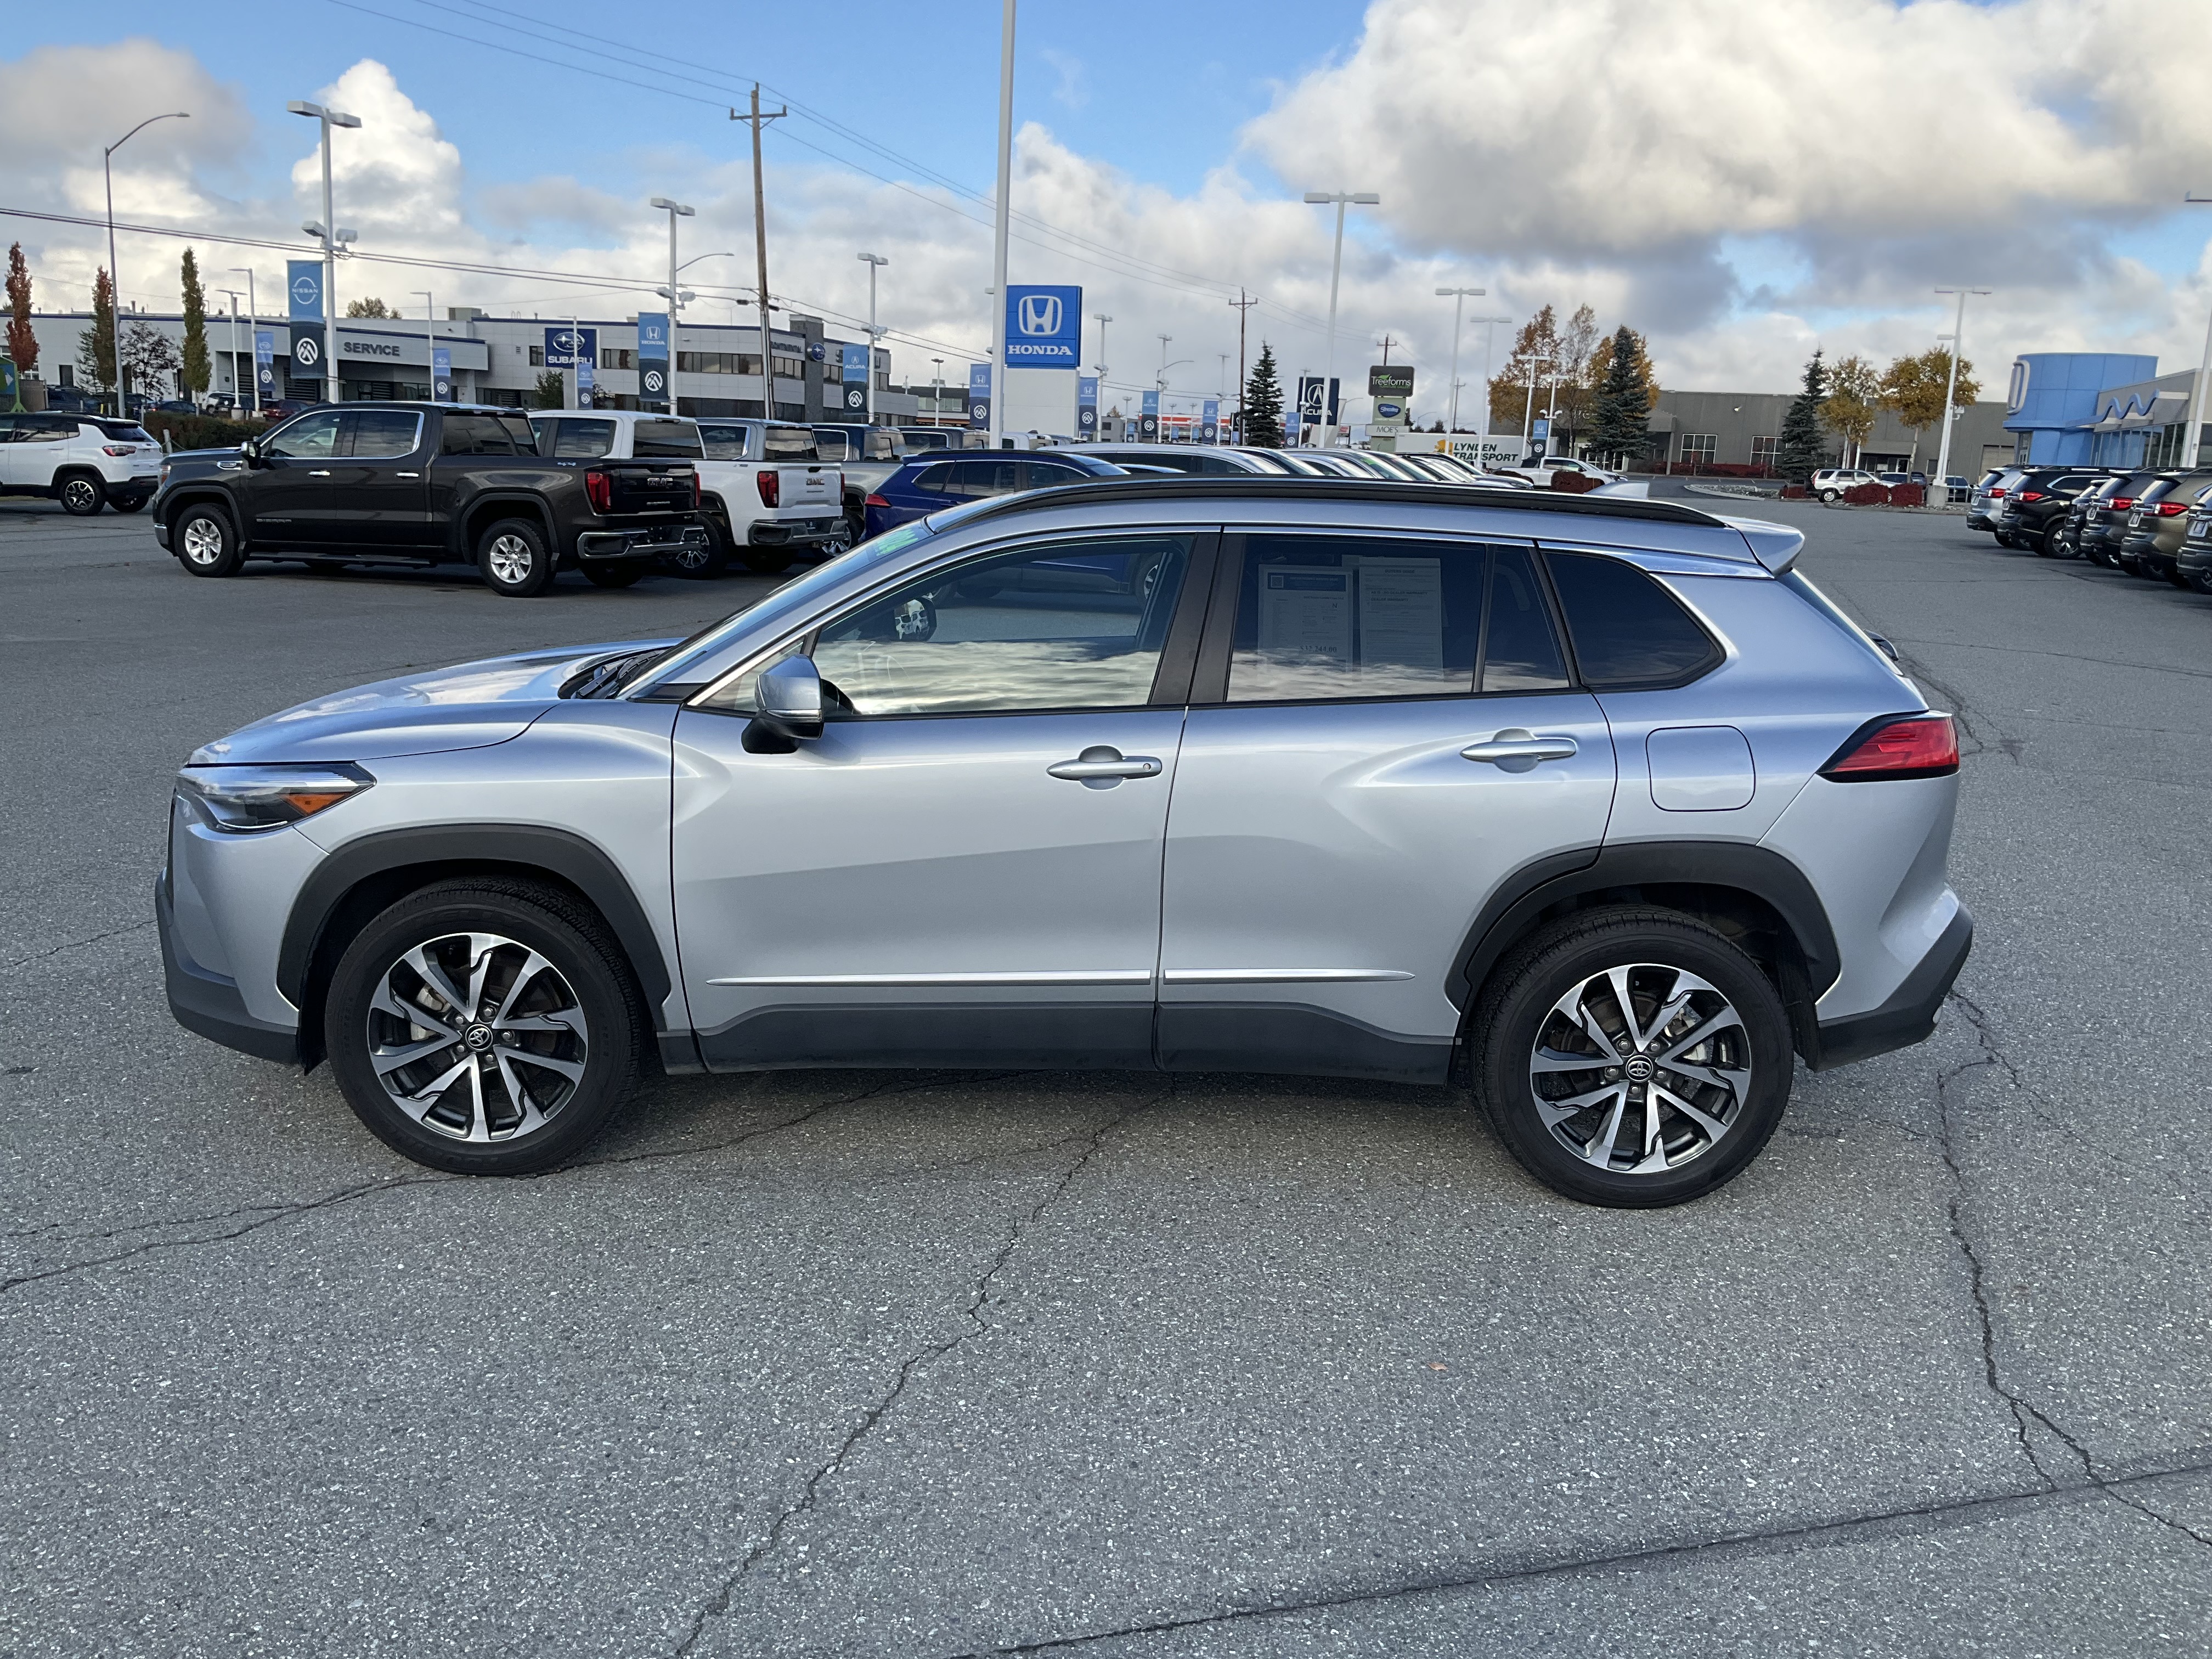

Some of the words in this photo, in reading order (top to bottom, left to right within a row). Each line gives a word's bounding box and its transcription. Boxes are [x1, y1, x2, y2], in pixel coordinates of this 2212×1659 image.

[344, 342, 400, 356] SERVICE
[1007, 345, 1073, 356] HONDA
[548, 356, 592, 364] SUBARU
[1372, 376, 1412, 386] Treeforms
[647, 478, 673, 487] GMC
